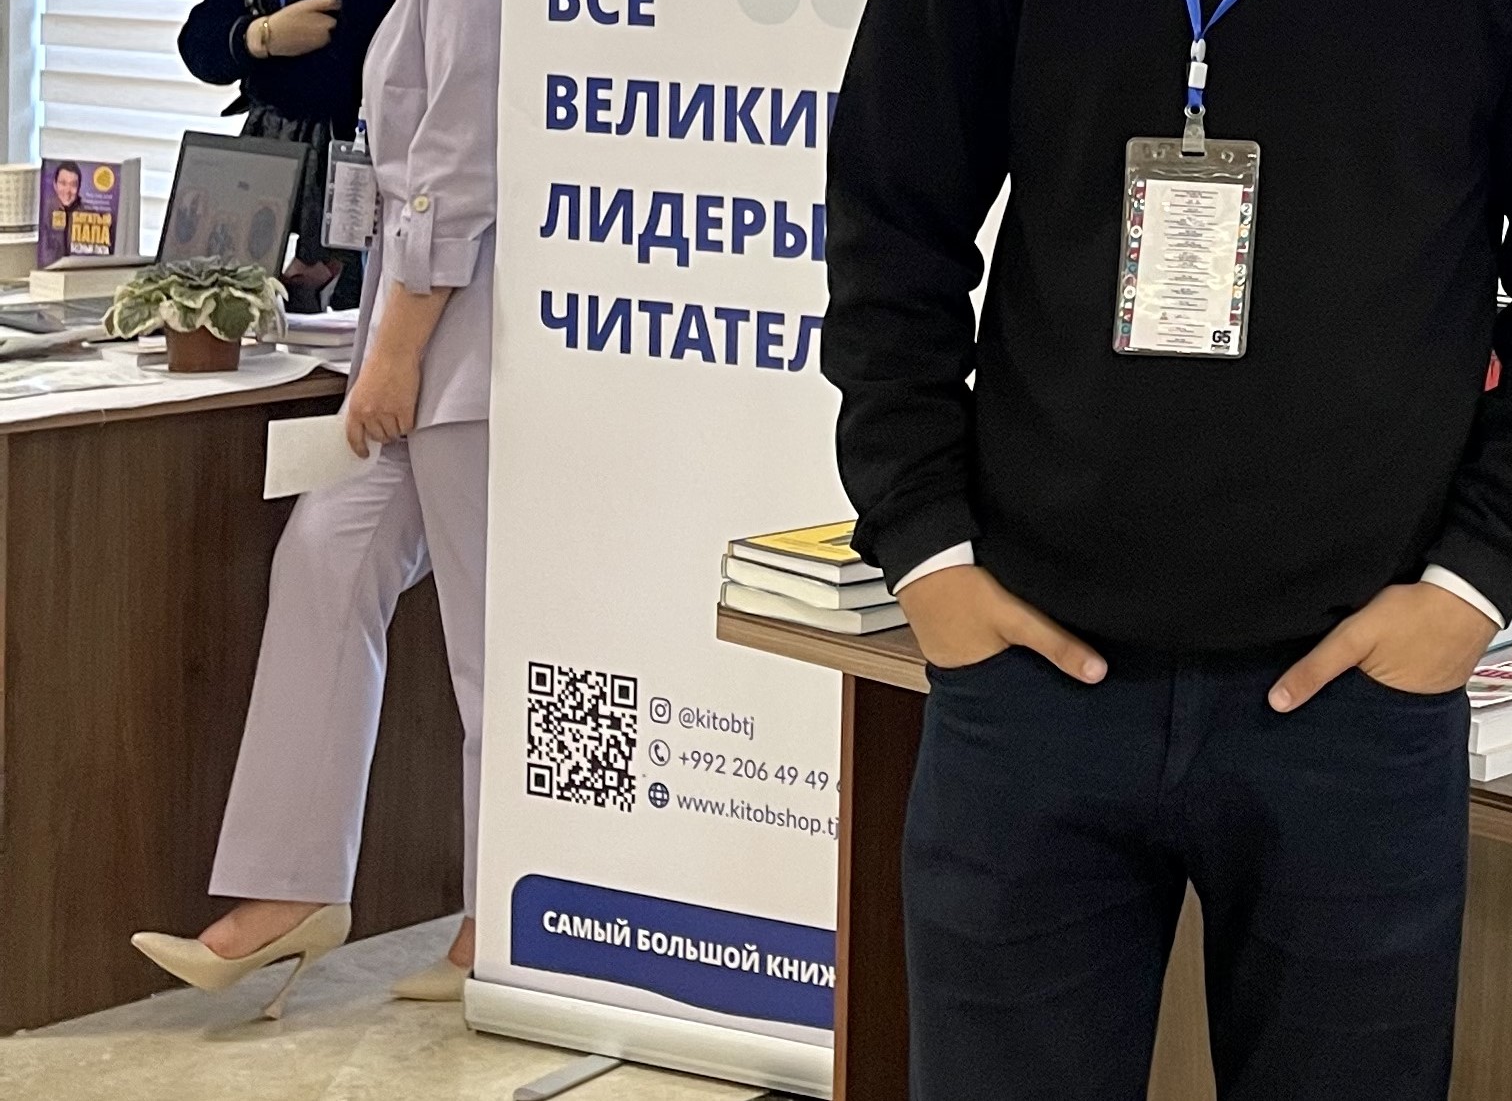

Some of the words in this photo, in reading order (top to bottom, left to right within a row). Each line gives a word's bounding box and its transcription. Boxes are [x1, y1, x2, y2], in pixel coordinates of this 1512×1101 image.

[71, 224, 111, 245] ПАПА
[540, 182, 826, 268] ЛИДЕРЫ
[1212, 329, 1231, 344] G5
[678, 706, 755, 741] @kitobtj
[678, 750, 726, 775] +992
[732, 756, 768, 782] 206
[774, 764, 799, 786] 49
[804, 770, 829, 792] 49
[676, 791, 841, 840] www.kitobshop.tj
[542, 910, 631, 948] САМЫЙ
[636, 928, 760, 974] БОЛЬШОЙ
